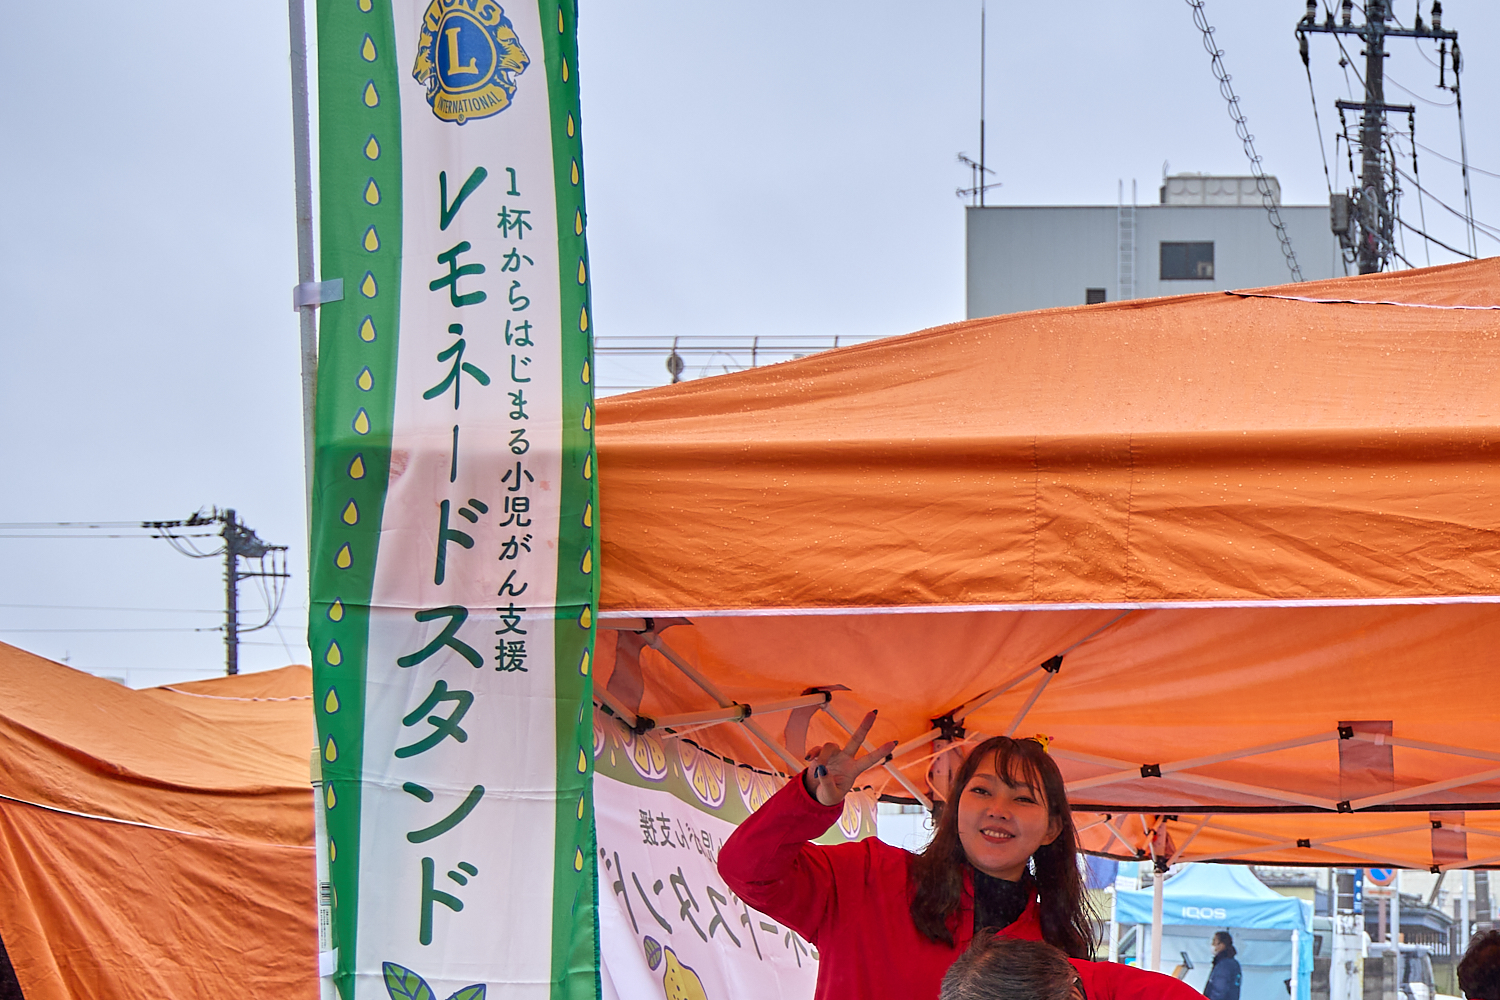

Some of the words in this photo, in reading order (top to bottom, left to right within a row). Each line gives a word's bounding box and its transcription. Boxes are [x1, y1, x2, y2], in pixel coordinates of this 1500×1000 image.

[445, 27, 479, 76] L
[437, 91, 502, 114] INTERNATIONAL
[494, 167, 534, 673] 1杯からはじまる小児がん支援
[394, 166, 490, 946] レモネードスタンド
[1182, 907, 1227, 919] IQOS
